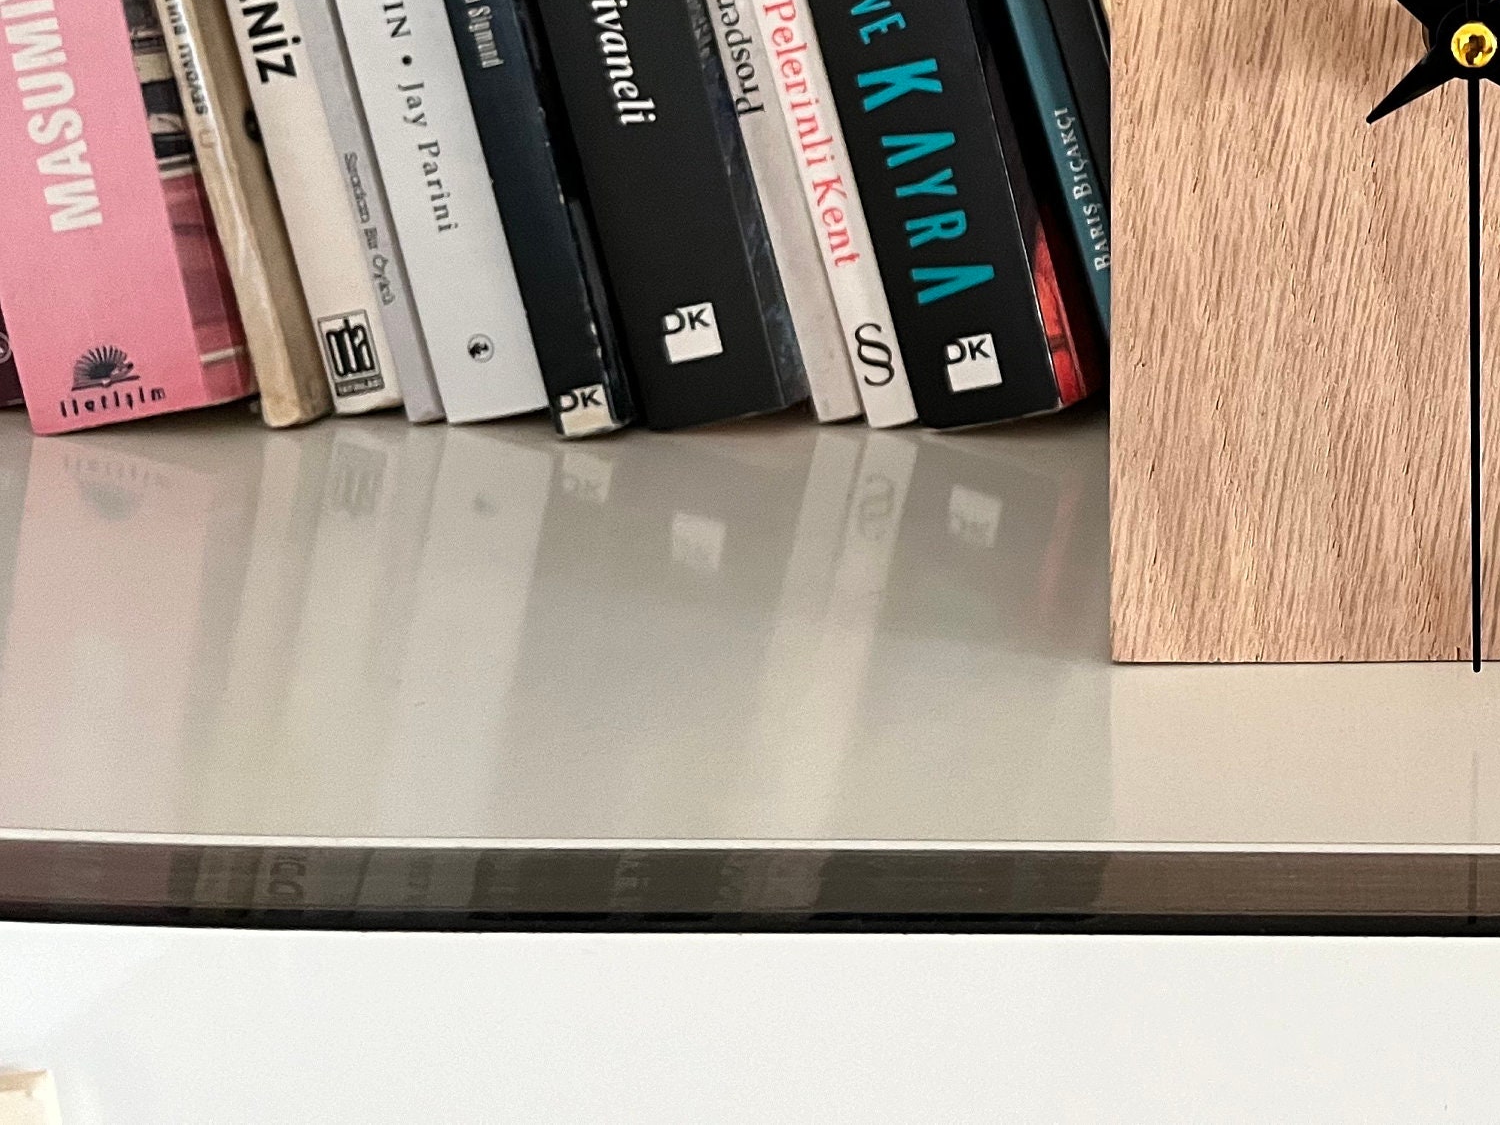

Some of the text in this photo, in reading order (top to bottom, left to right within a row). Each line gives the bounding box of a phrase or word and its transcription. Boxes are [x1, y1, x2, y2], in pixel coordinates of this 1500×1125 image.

[397, 82, 428, 129] Jay
[417, 140, 459, 234] Parini
[857, 58, 995, 306] KAYRA
[811, 179, 861, 268] Kent
[661, 307, 711, 335] DK
[944, 338, 990, 364] DK
[558, 389, 602, 412] DK
